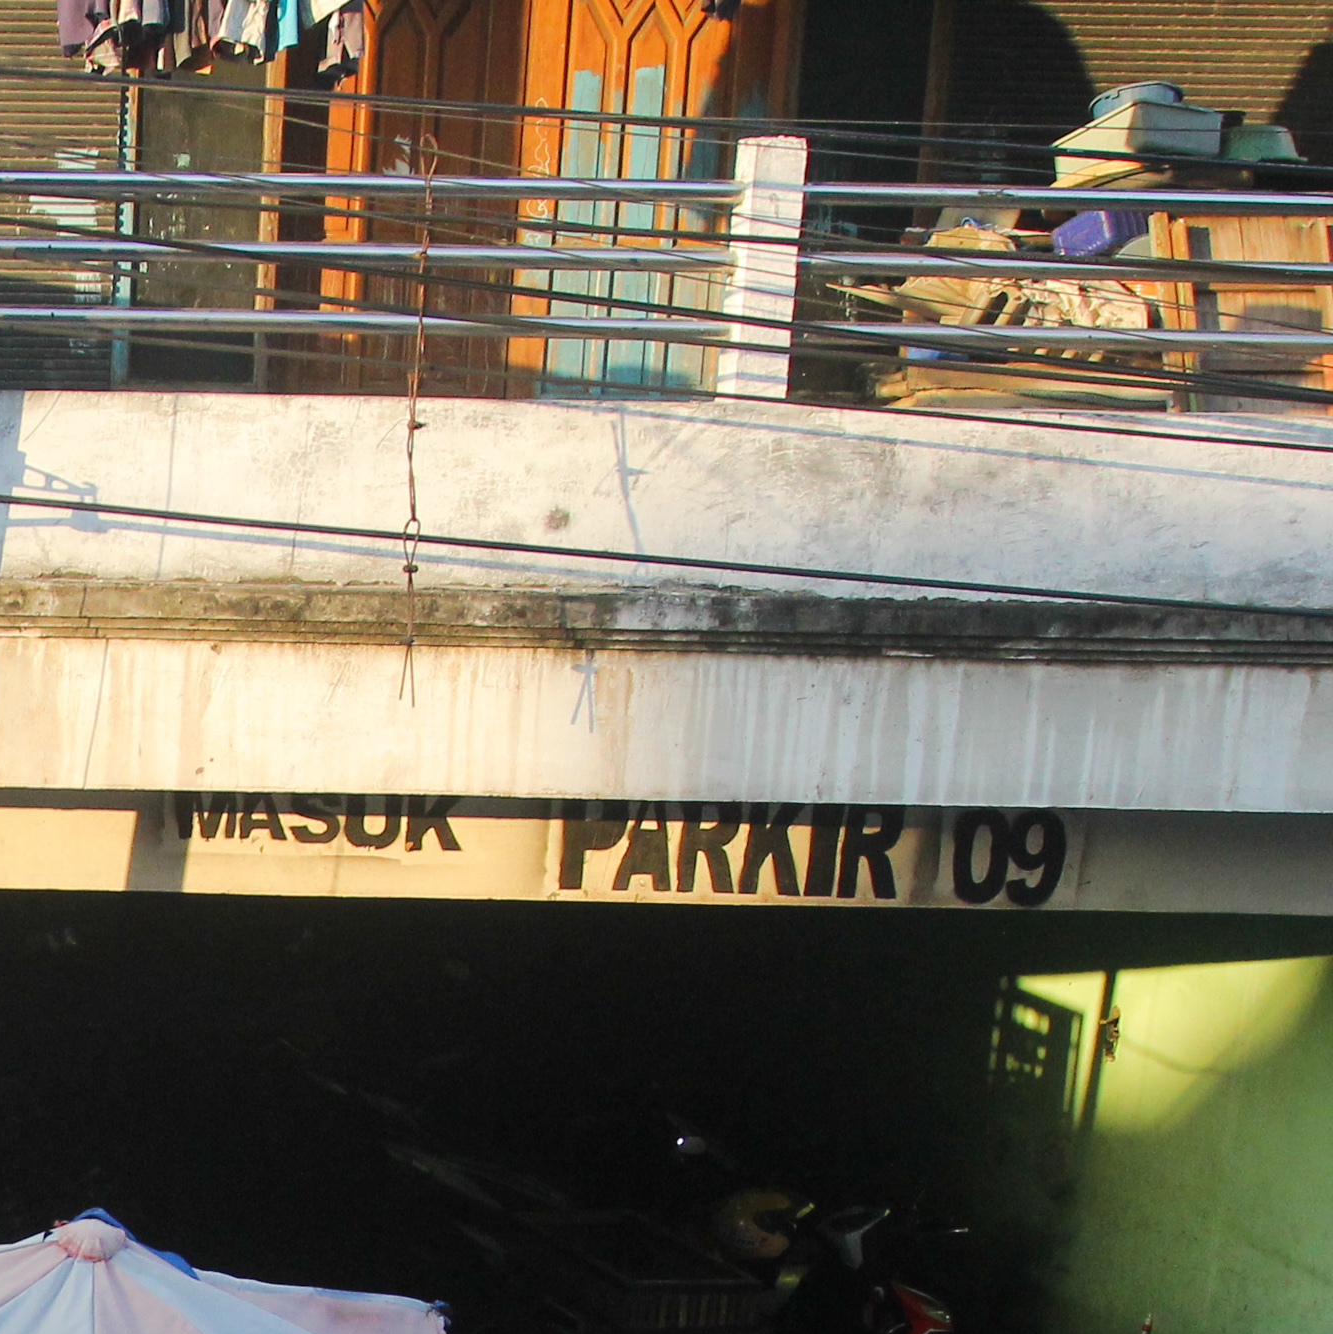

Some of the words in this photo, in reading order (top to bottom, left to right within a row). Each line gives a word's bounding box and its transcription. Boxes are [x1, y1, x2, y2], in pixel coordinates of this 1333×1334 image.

[175, 792, 463, 852] MASUK
[558, 800, 908, 899] PARKIR
[951, 804, 1069, 907] 09
